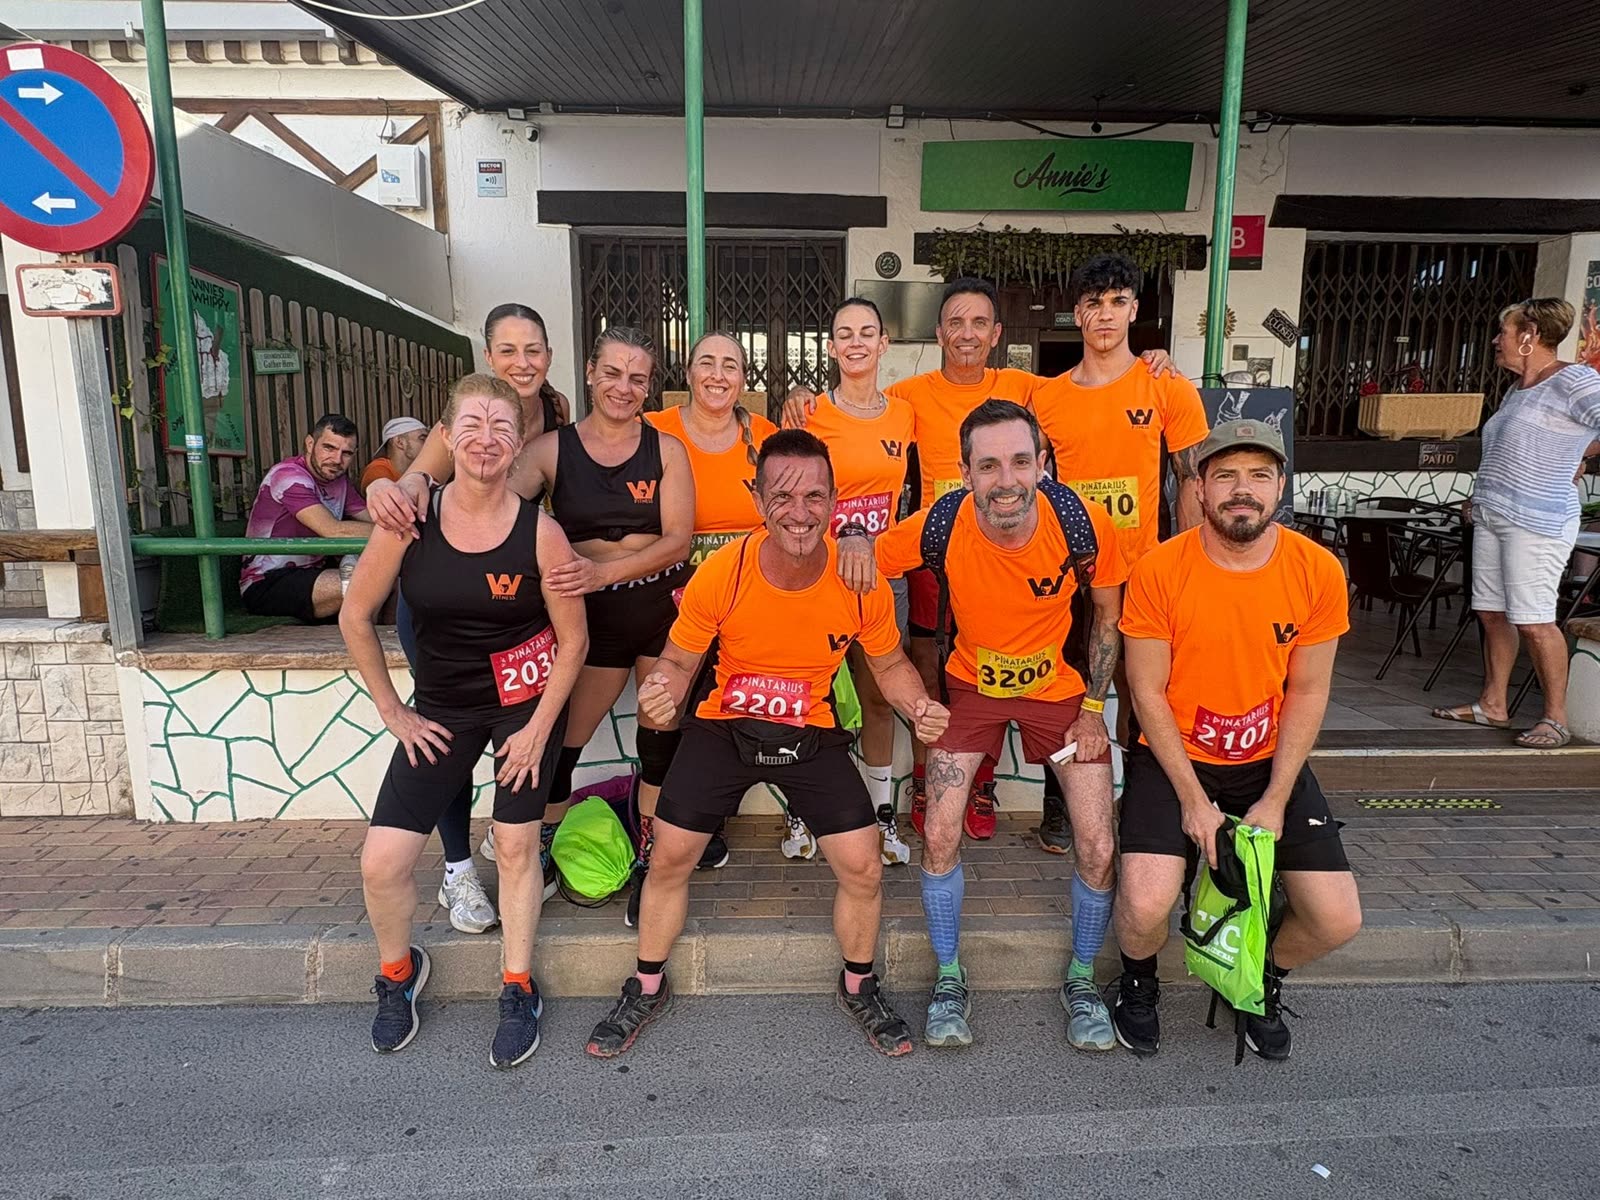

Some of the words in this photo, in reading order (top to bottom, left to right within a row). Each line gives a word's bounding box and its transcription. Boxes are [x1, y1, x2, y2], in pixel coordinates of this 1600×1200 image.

[1014, 152, 1112, 190] Annie's
[191, 290, 230, 312] WHIPPY
[1269, 317, 1296, 341] CLOSED
[1423, 454, 1454, 464] PATIO
[1081, 480, 1128, 491] PINATARIUS
[842, 495, 890, 509] PINATARIUS
[1090, 493, 1134, 517] 10
[835, 508, 890, 534] 2082
[995, 651, 1047, 666] PINATARIUS
[740, 676, 804, 694] PINATARIUS
[981, 659, 1052, 688] 3200
[729, 690, 804, 717] 2201
[1212, 702, 1270, 727] PINATARIUS
[1197, 717, 1270, 750] 2107
